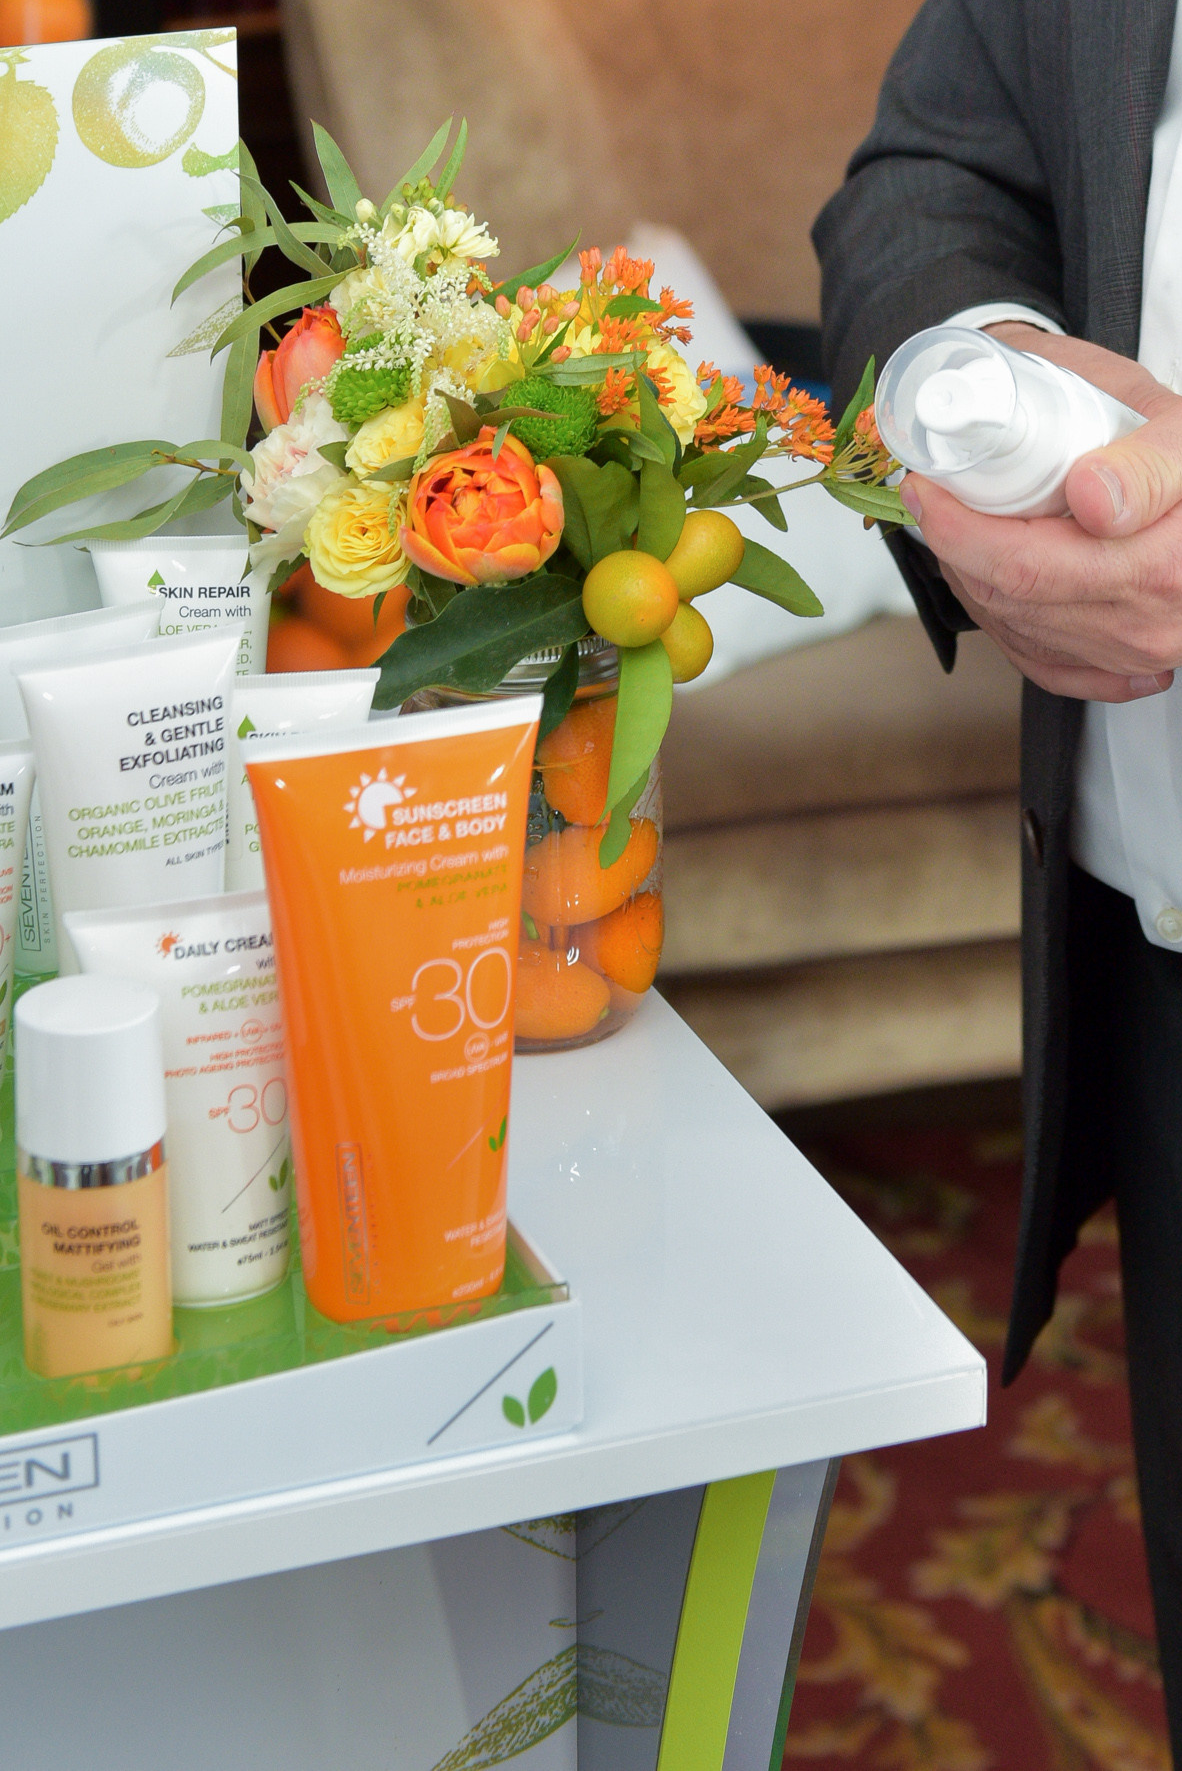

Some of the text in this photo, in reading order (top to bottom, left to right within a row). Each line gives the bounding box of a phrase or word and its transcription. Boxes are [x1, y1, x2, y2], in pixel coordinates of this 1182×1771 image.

[159, 586, 250, 598] SKIN REPAIR
[179, 605, 252, 618] Cream with
[127, 696, 224, 727] CLEANSING
[145, 717, 224, 746] & GENTLE
[120, 738, 224, 772] EXFOLIATING
[149, 760, 224, 790] Cream with
[68, 800, 141, 822] ORGANIC
[144, 791, 188, 811] OLIVE
[392, 792, 508, 826] SUNSCREEN
[68, 836, 160, 859] CHAMOMILE
[163, 816, 224, 846] EXTRACTS
[76, 818, 148, 841] ORANGE,
[152, 806, 218, 829] MORINGA
[385, 812, 508, 850] FACE & BODY
[166, 857, 182, 867] ALL
[340, 843, 510, 885] Moisturizing Cream with
[34, 815, 50, 944] SKIN PERFECTION
[174, 940, 220, 960] DAILY
[198, 990, 278, 1015] & ALOE VER
[411, 946, 512, 1042] 30
[228, 1076, 288, 1134] 30
[41, 1218, 140, 1240] OIL CONTROL
[54, 1234, 141, 1256] MATTIFYING
